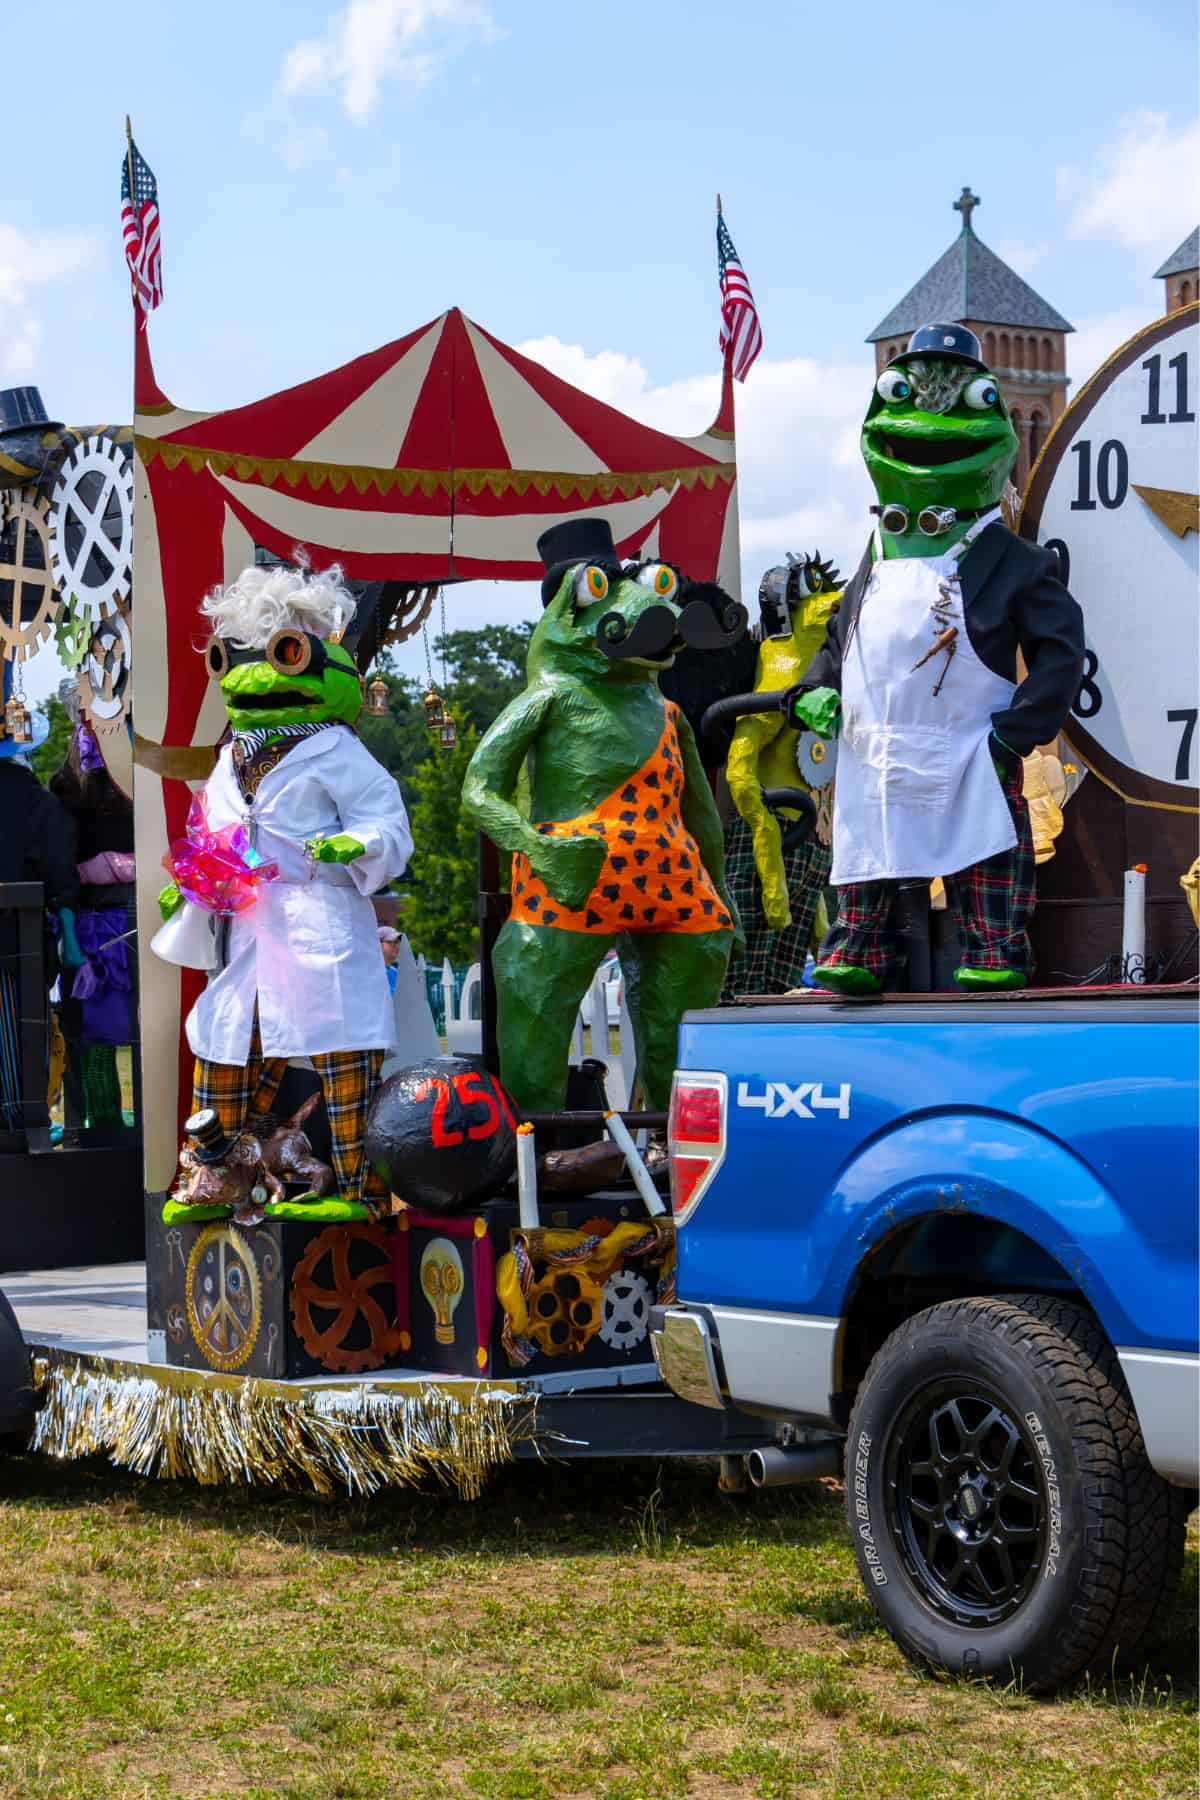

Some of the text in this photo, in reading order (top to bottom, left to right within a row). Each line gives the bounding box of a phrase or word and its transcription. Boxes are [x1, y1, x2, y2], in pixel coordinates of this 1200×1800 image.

[1141, 352, 1195, 424] 11
[1071, 439, 1129, 511] 10
[1072, 649, 1103, 718] 8
[1168, 708, 1198, 780] 7
[855, 1431, 888, 1586] GRABBER
[1025, 1411, 1062, 1579] GENERAL
